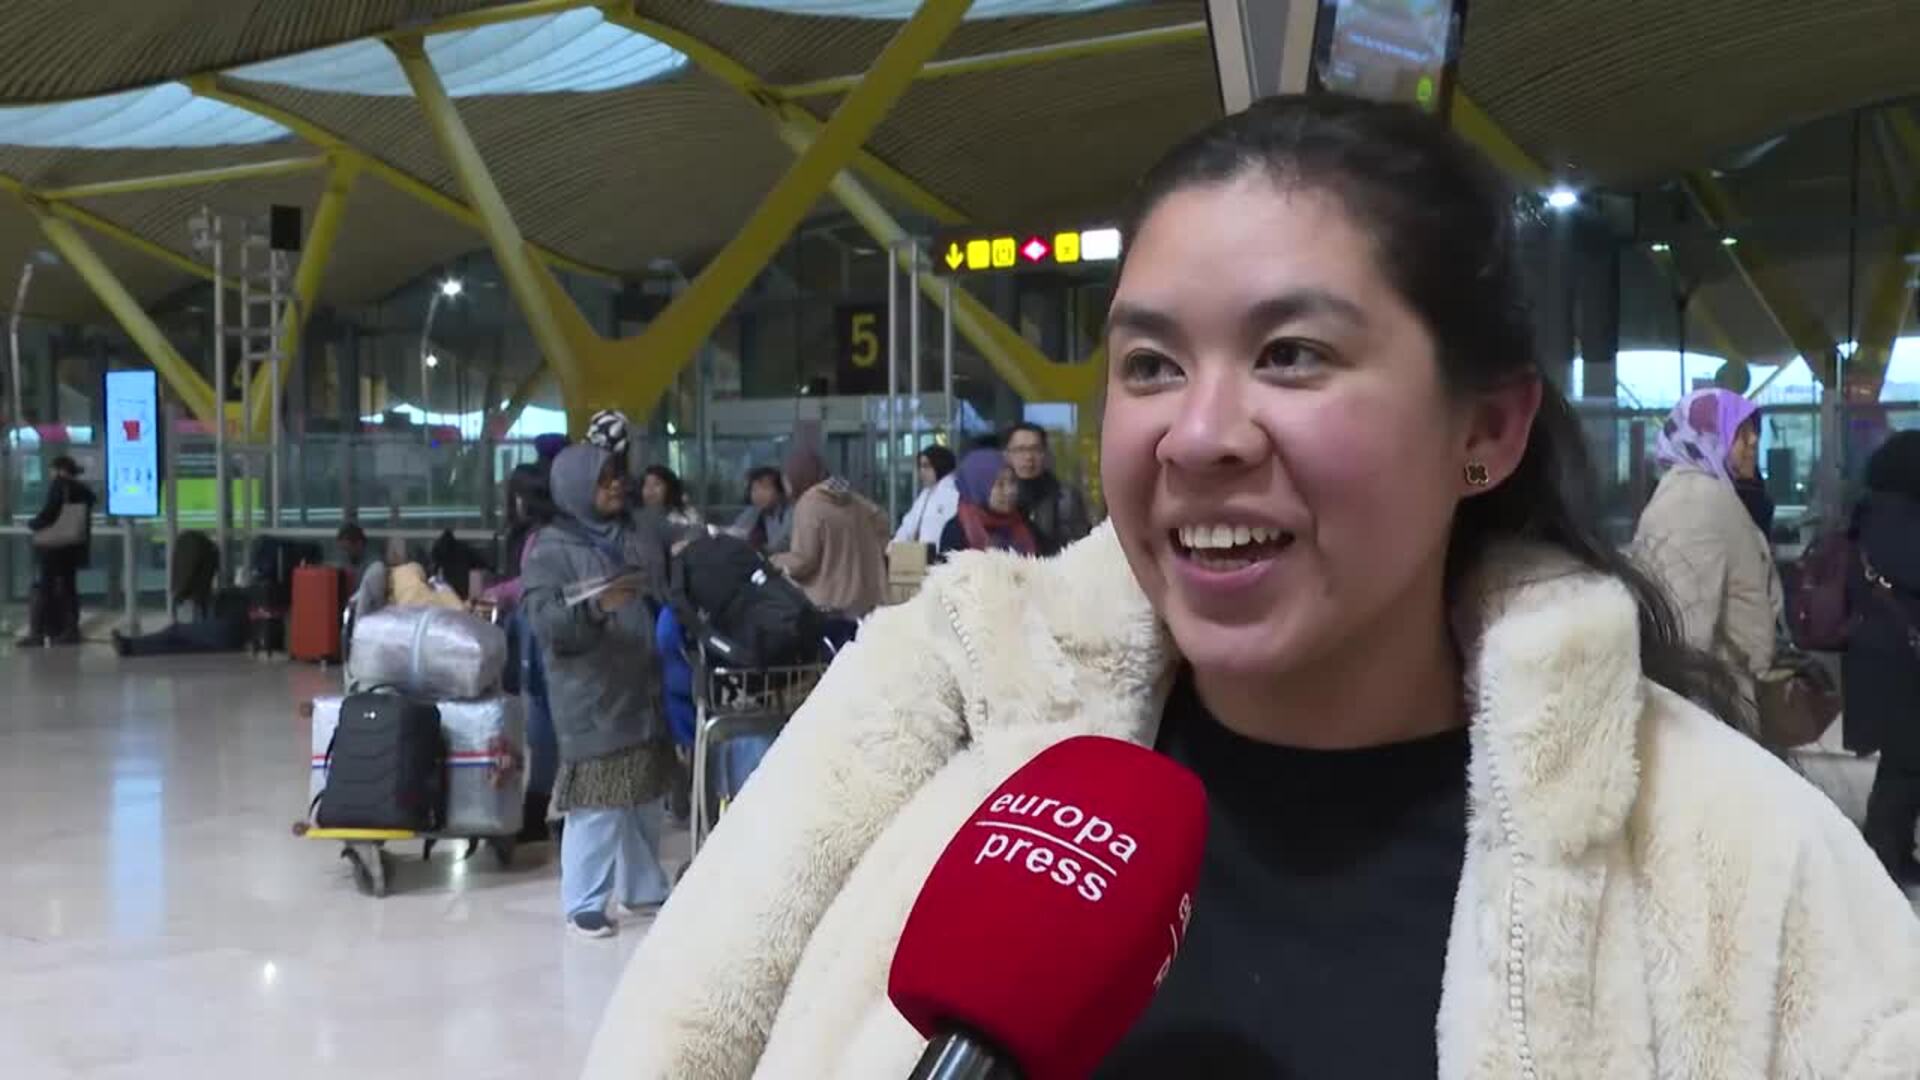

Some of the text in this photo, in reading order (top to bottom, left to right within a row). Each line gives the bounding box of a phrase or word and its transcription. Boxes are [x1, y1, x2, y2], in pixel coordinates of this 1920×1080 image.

[851, 312, 879, 367] 5
[989, 793, 1138, 864] europa
[974, 833, 1108, 901] press
